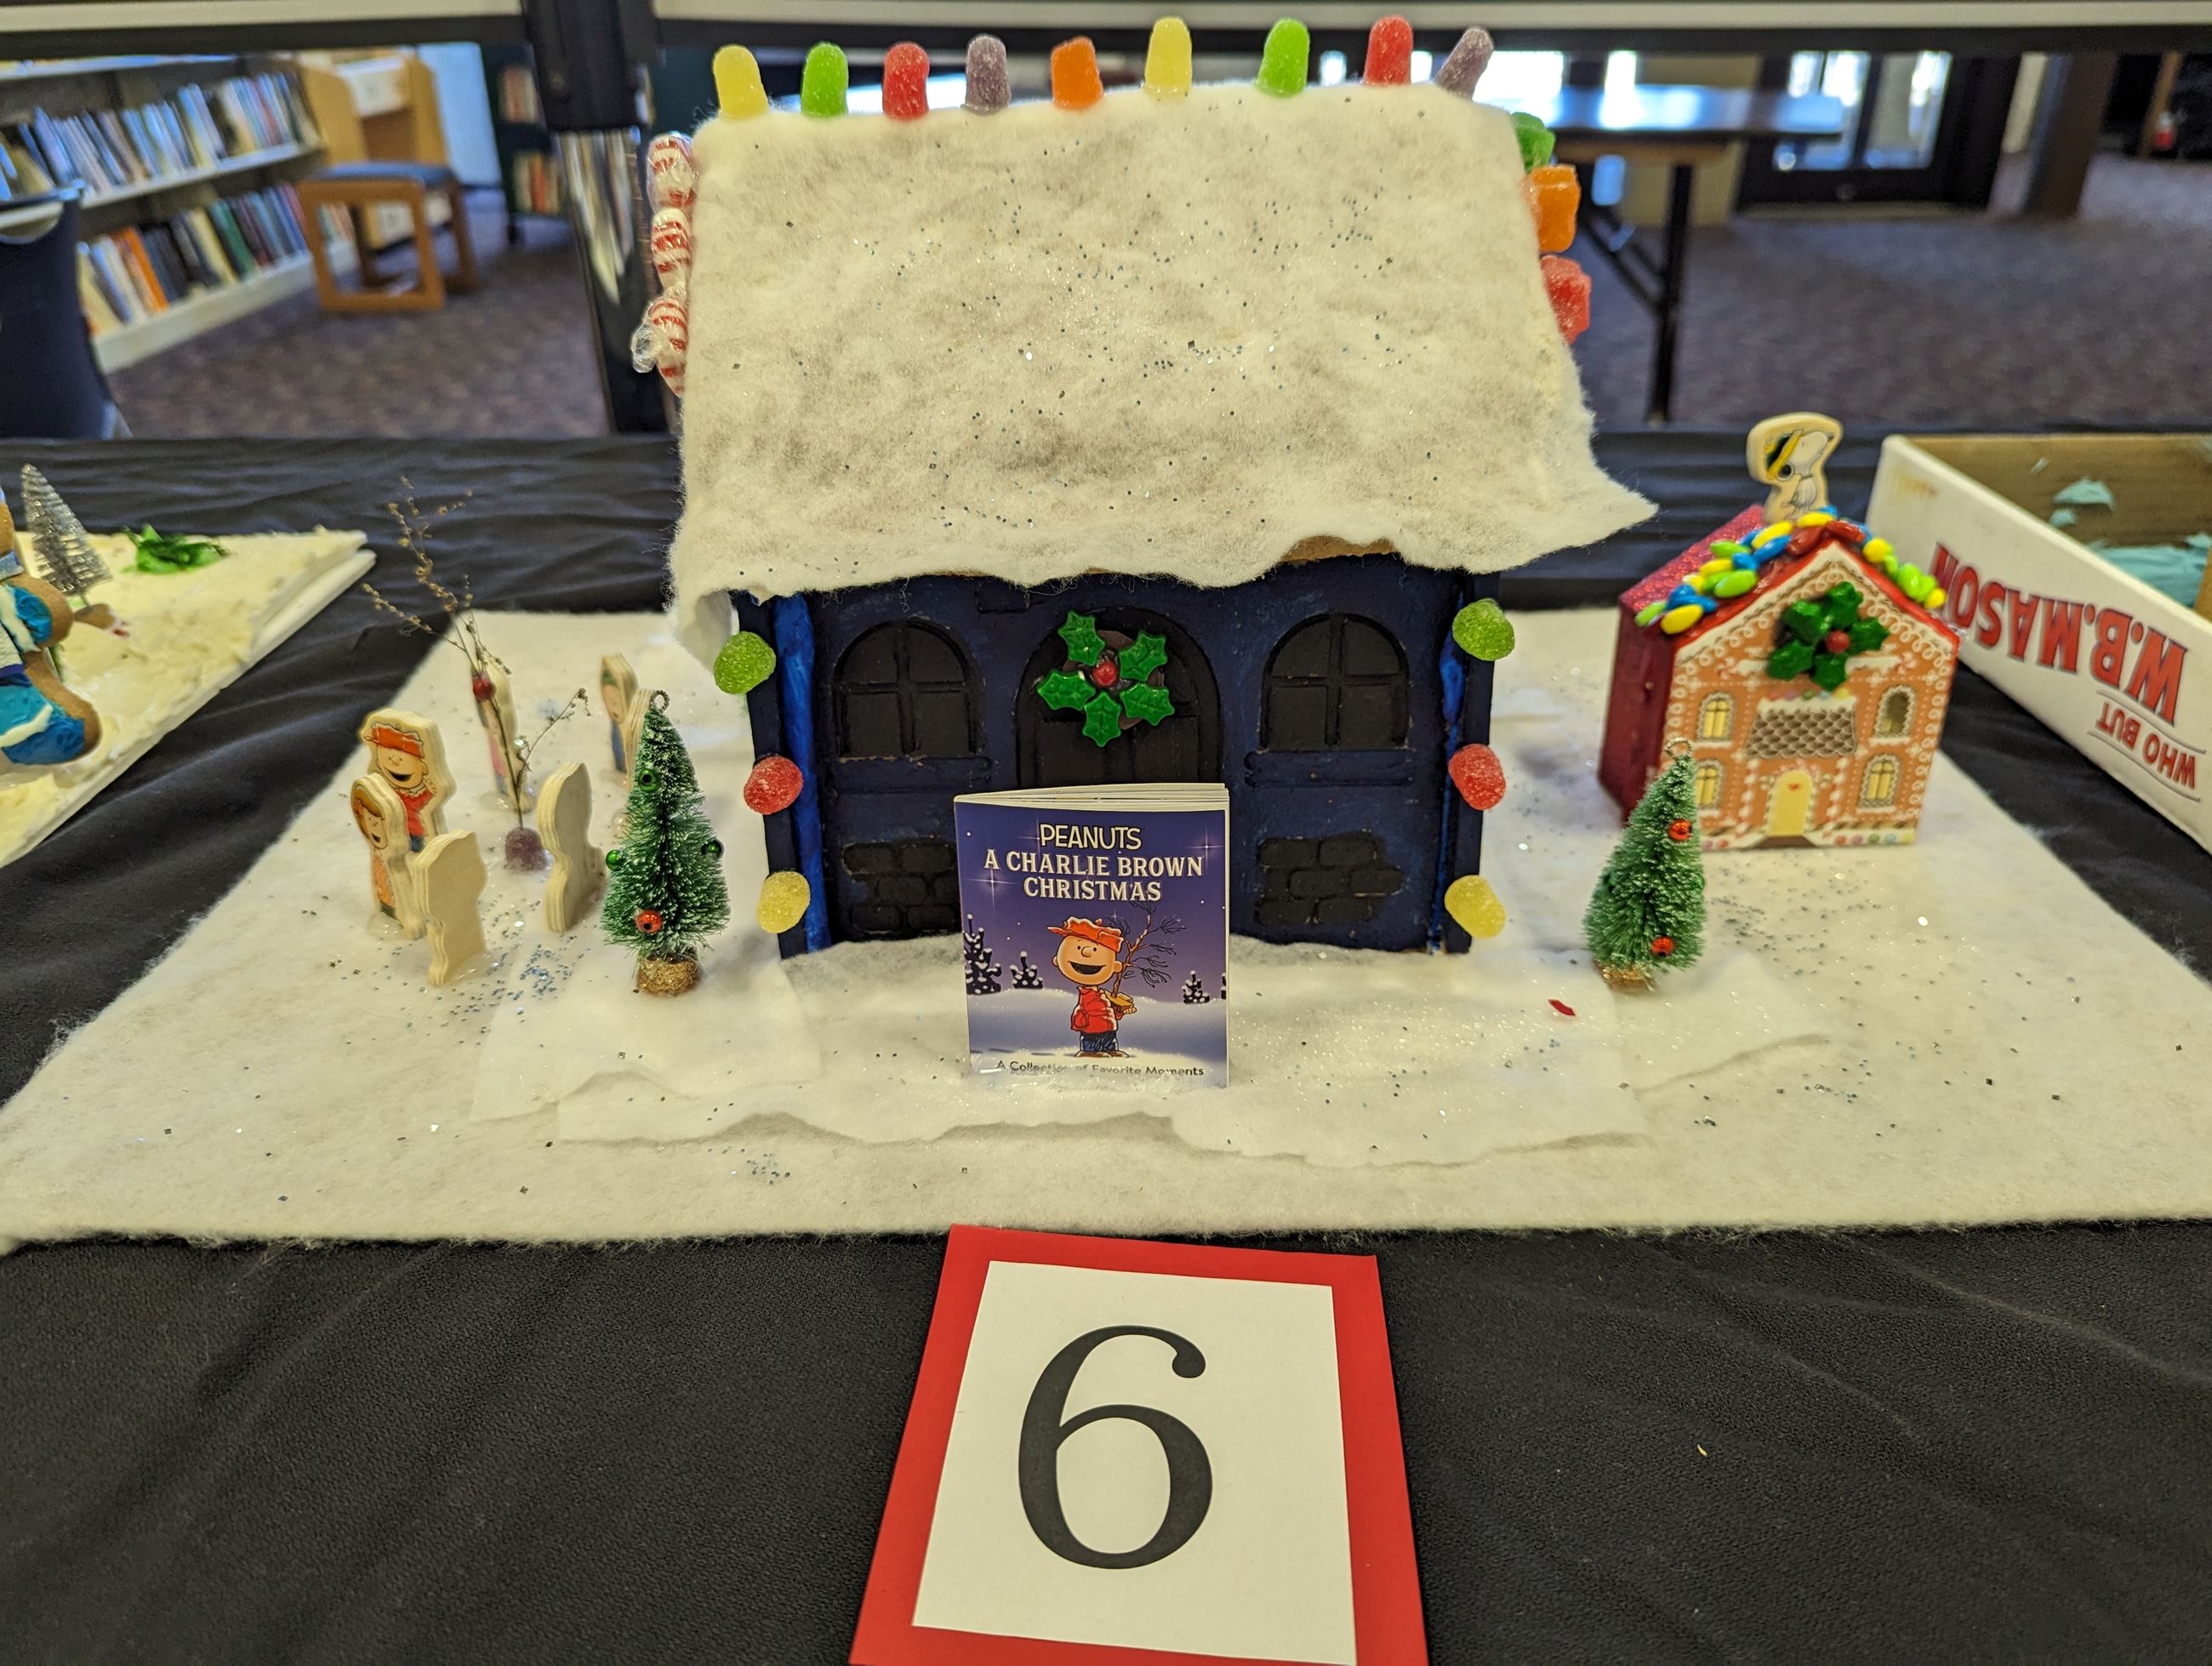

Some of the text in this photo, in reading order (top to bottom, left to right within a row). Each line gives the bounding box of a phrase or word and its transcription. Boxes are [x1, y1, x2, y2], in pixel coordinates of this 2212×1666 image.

[2095, 702, 2197, 790] WHO BUT
[1039, 823, 1143, 851] PEANUTS
[983, 849, 1204, 878] A CHARLIE BROWN
[1023, 876, 1163, 903] CHRISTMAS
[996, 1059, 1006, 1070] A
[1009, 1060, 1069, 1074] Collectio
[1092, 1064, 1142, 1075] Favorite
[1018, 1324, 1213, 1570] 6
